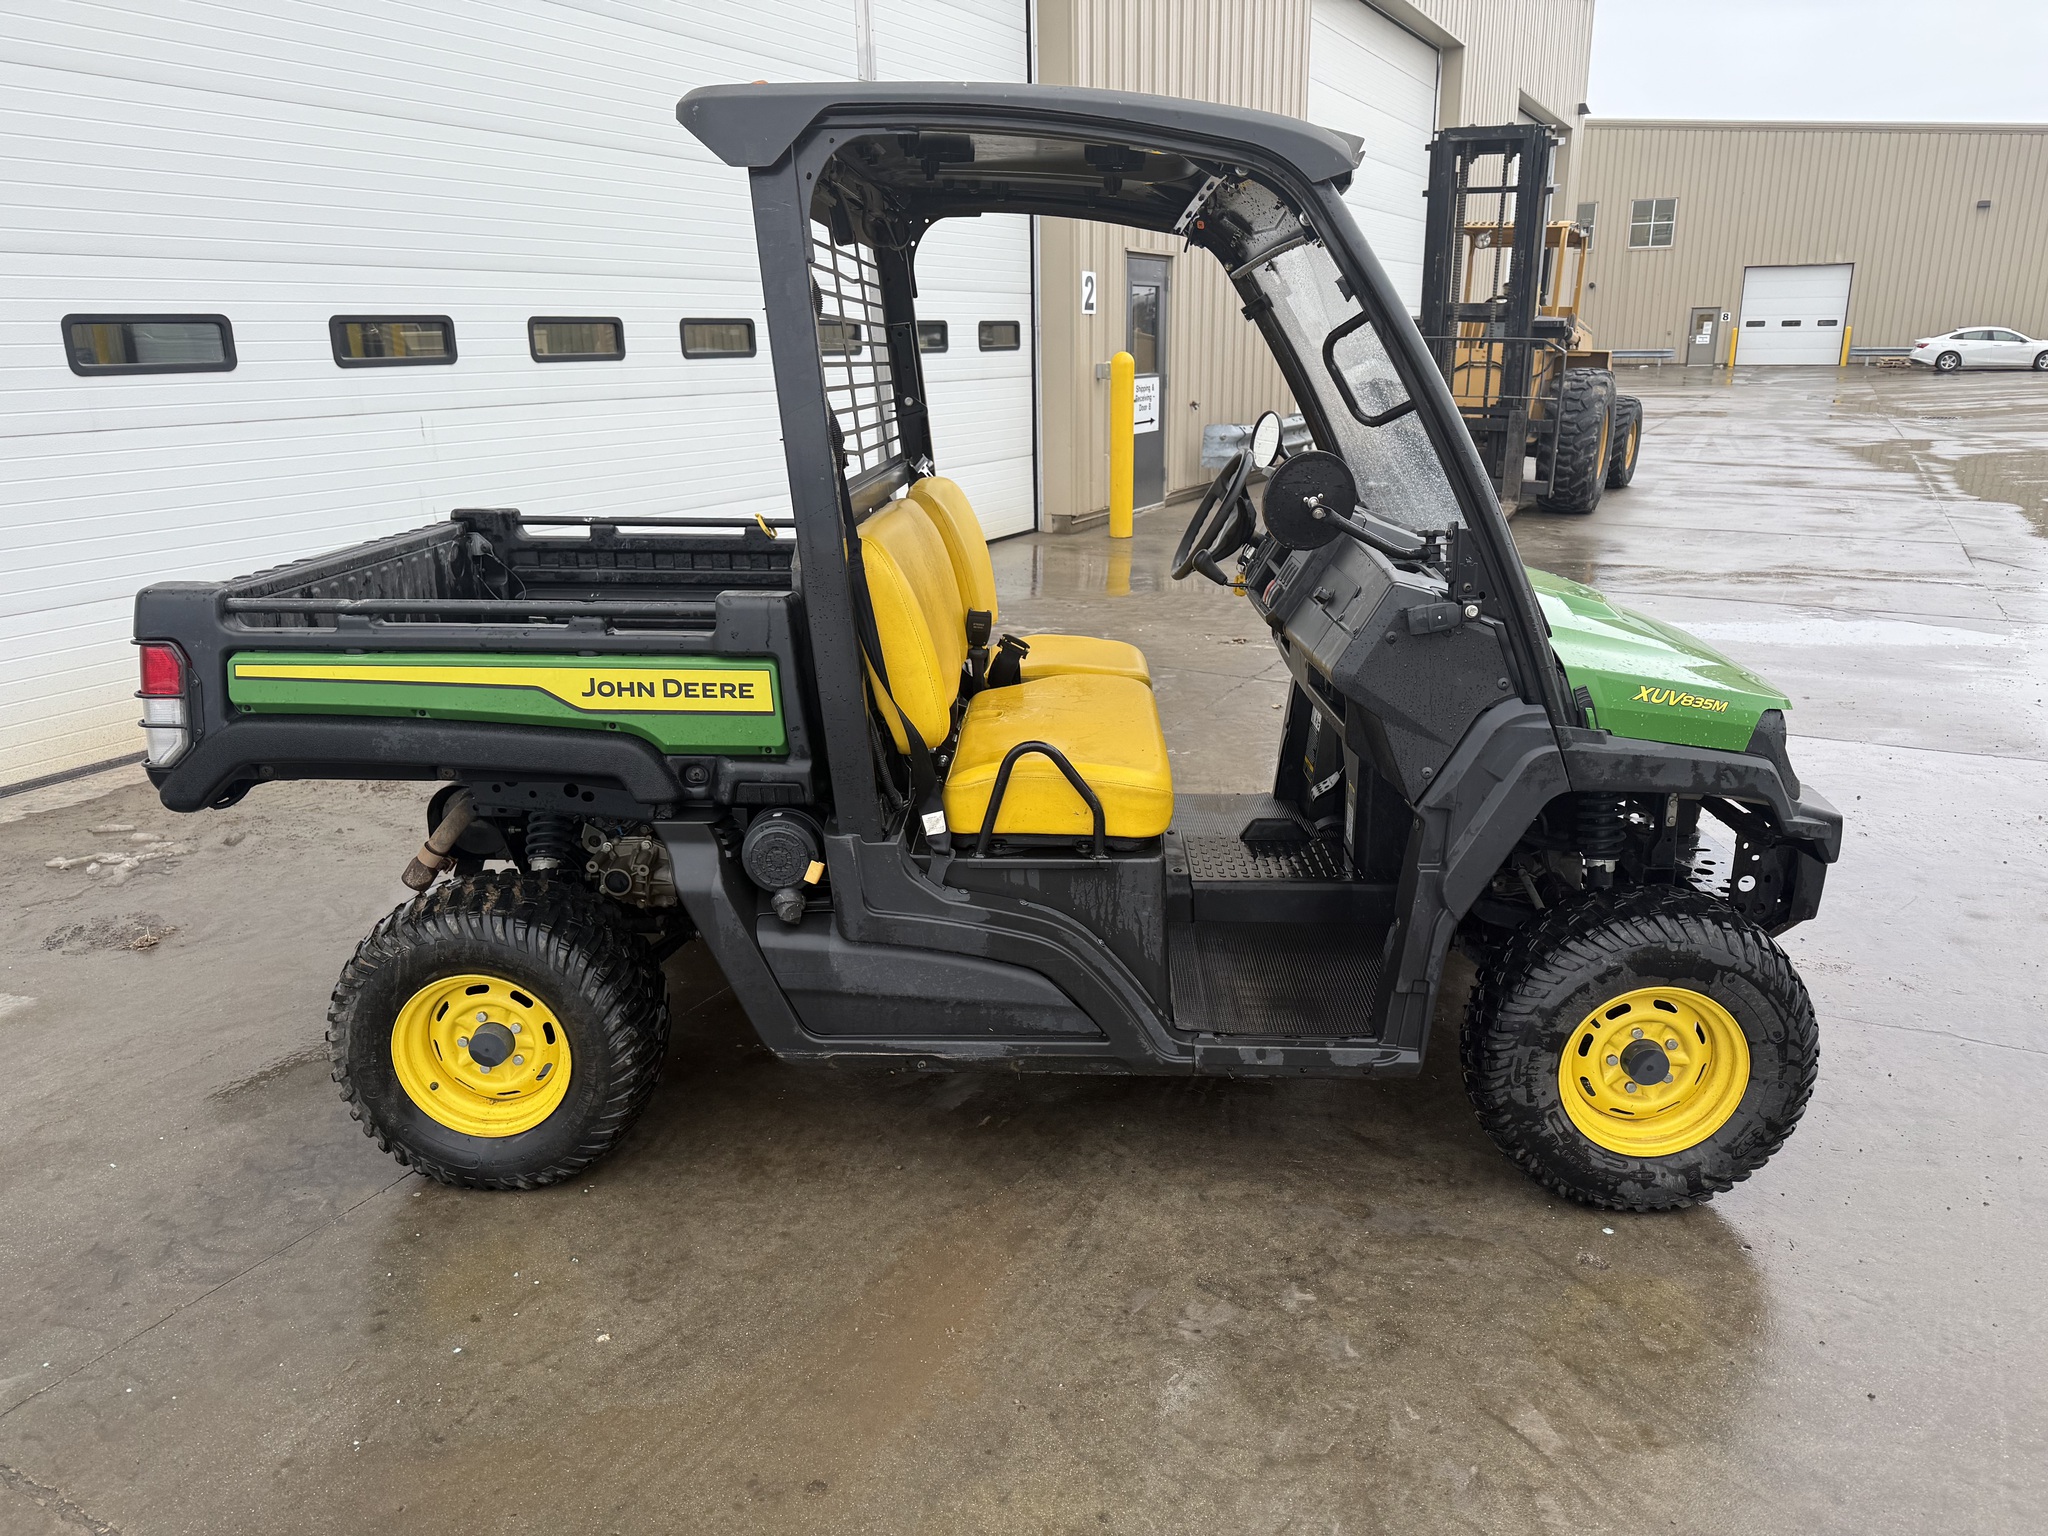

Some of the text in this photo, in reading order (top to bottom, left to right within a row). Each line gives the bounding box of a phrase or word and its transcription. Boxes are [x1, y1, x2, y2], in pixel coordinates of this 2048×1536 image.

[1084, 276, 1094, 310] 2
[1135, 384, 1151, 393] Shipping
[1138, 403, 1147, 411] Door
[581, 677, 755, 699] JOHN DEERE
[1632, 685, 1729, 713] XUV835M
